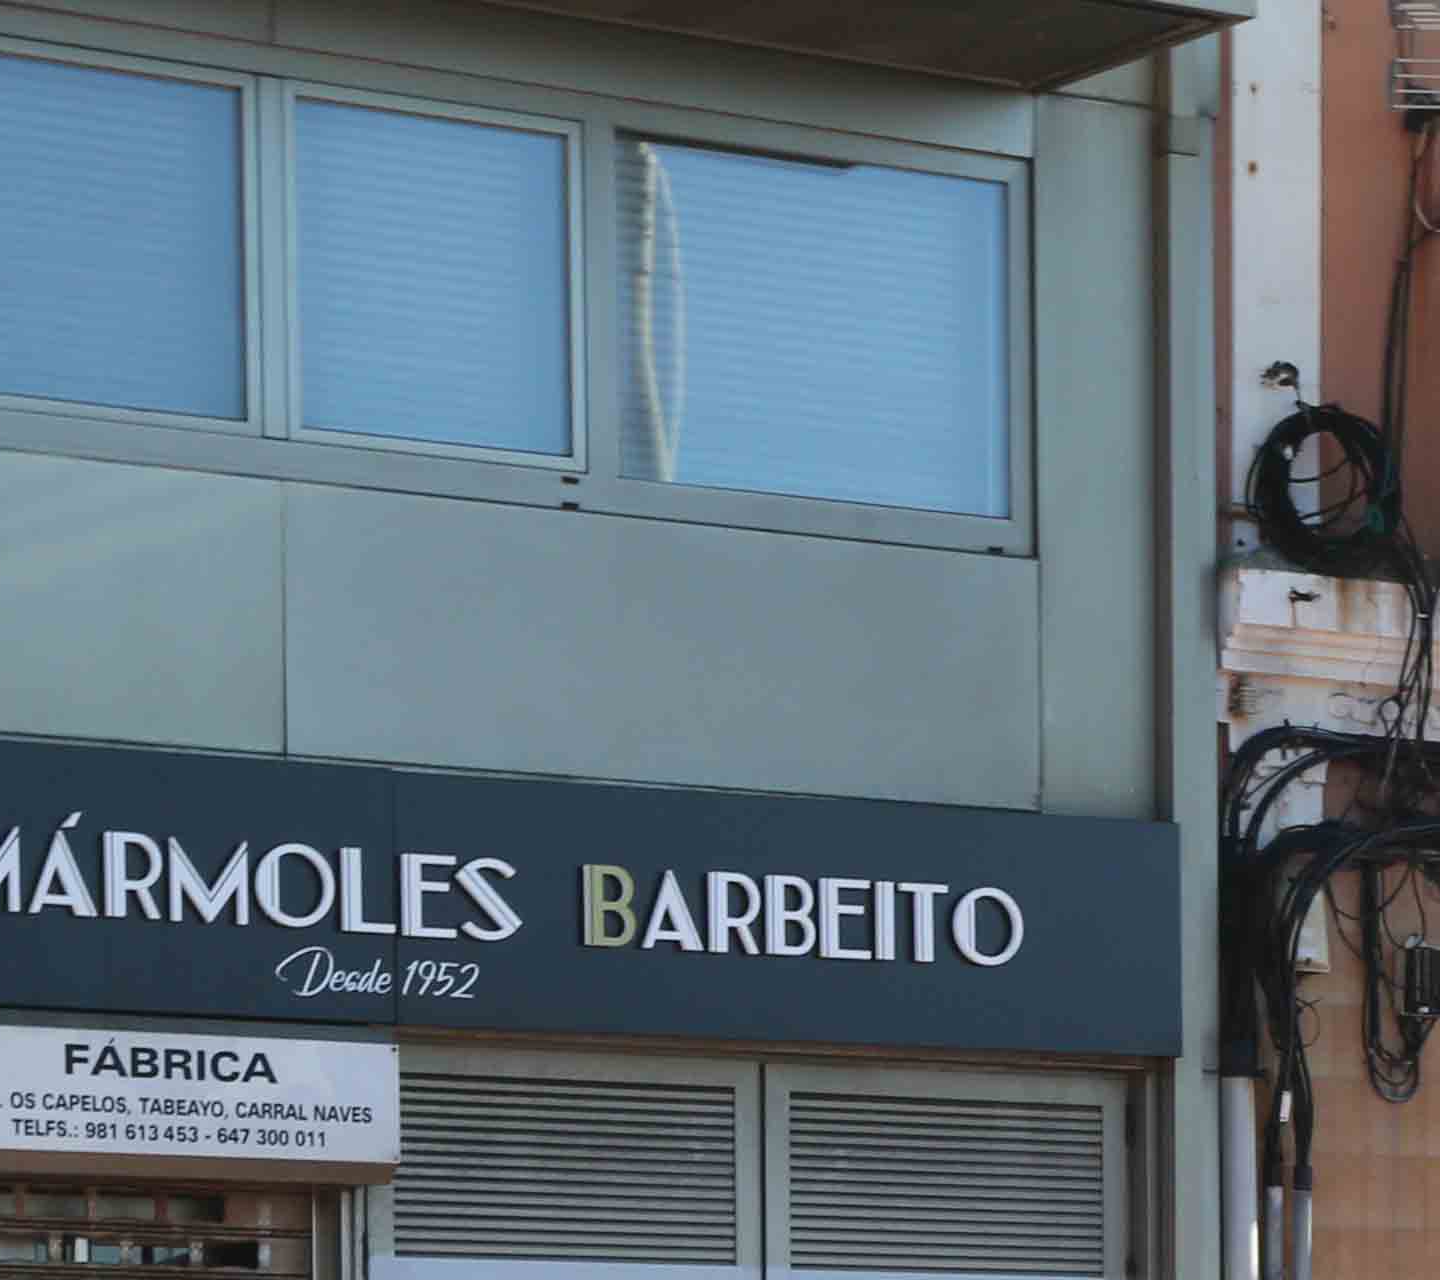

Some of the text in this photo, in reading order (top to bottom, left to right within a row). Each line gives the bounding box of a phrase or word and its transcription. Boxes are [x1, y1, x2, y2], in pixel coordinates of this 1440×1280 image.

[580, 863, 1025, 966] BARBEITO
[276, 945, 480, 999] Desde 1952
[64, 1038, 278, 1084] FÁBRICA
[10, 1092, 36, 1110] OS
[43, 1094, 131, 1116] CAPELOS,
[139, 1098, 229, 1120] TABEAYO,
[236, 1101, 308, 1121] CARRAL
[314, 1105, 372, 1124] NAVES
[13, 1119, 79, 1138] TELFS.:
[86, 1123, 116, 1140] 981
[126, 1124, 158, 1141] 613
[164, 1125, 199, 1143] 453
[218, 1128, 249, 1145] 647
[257, 1129, 288, 1146] 300
[295, 1130, 327, 1148] 011
